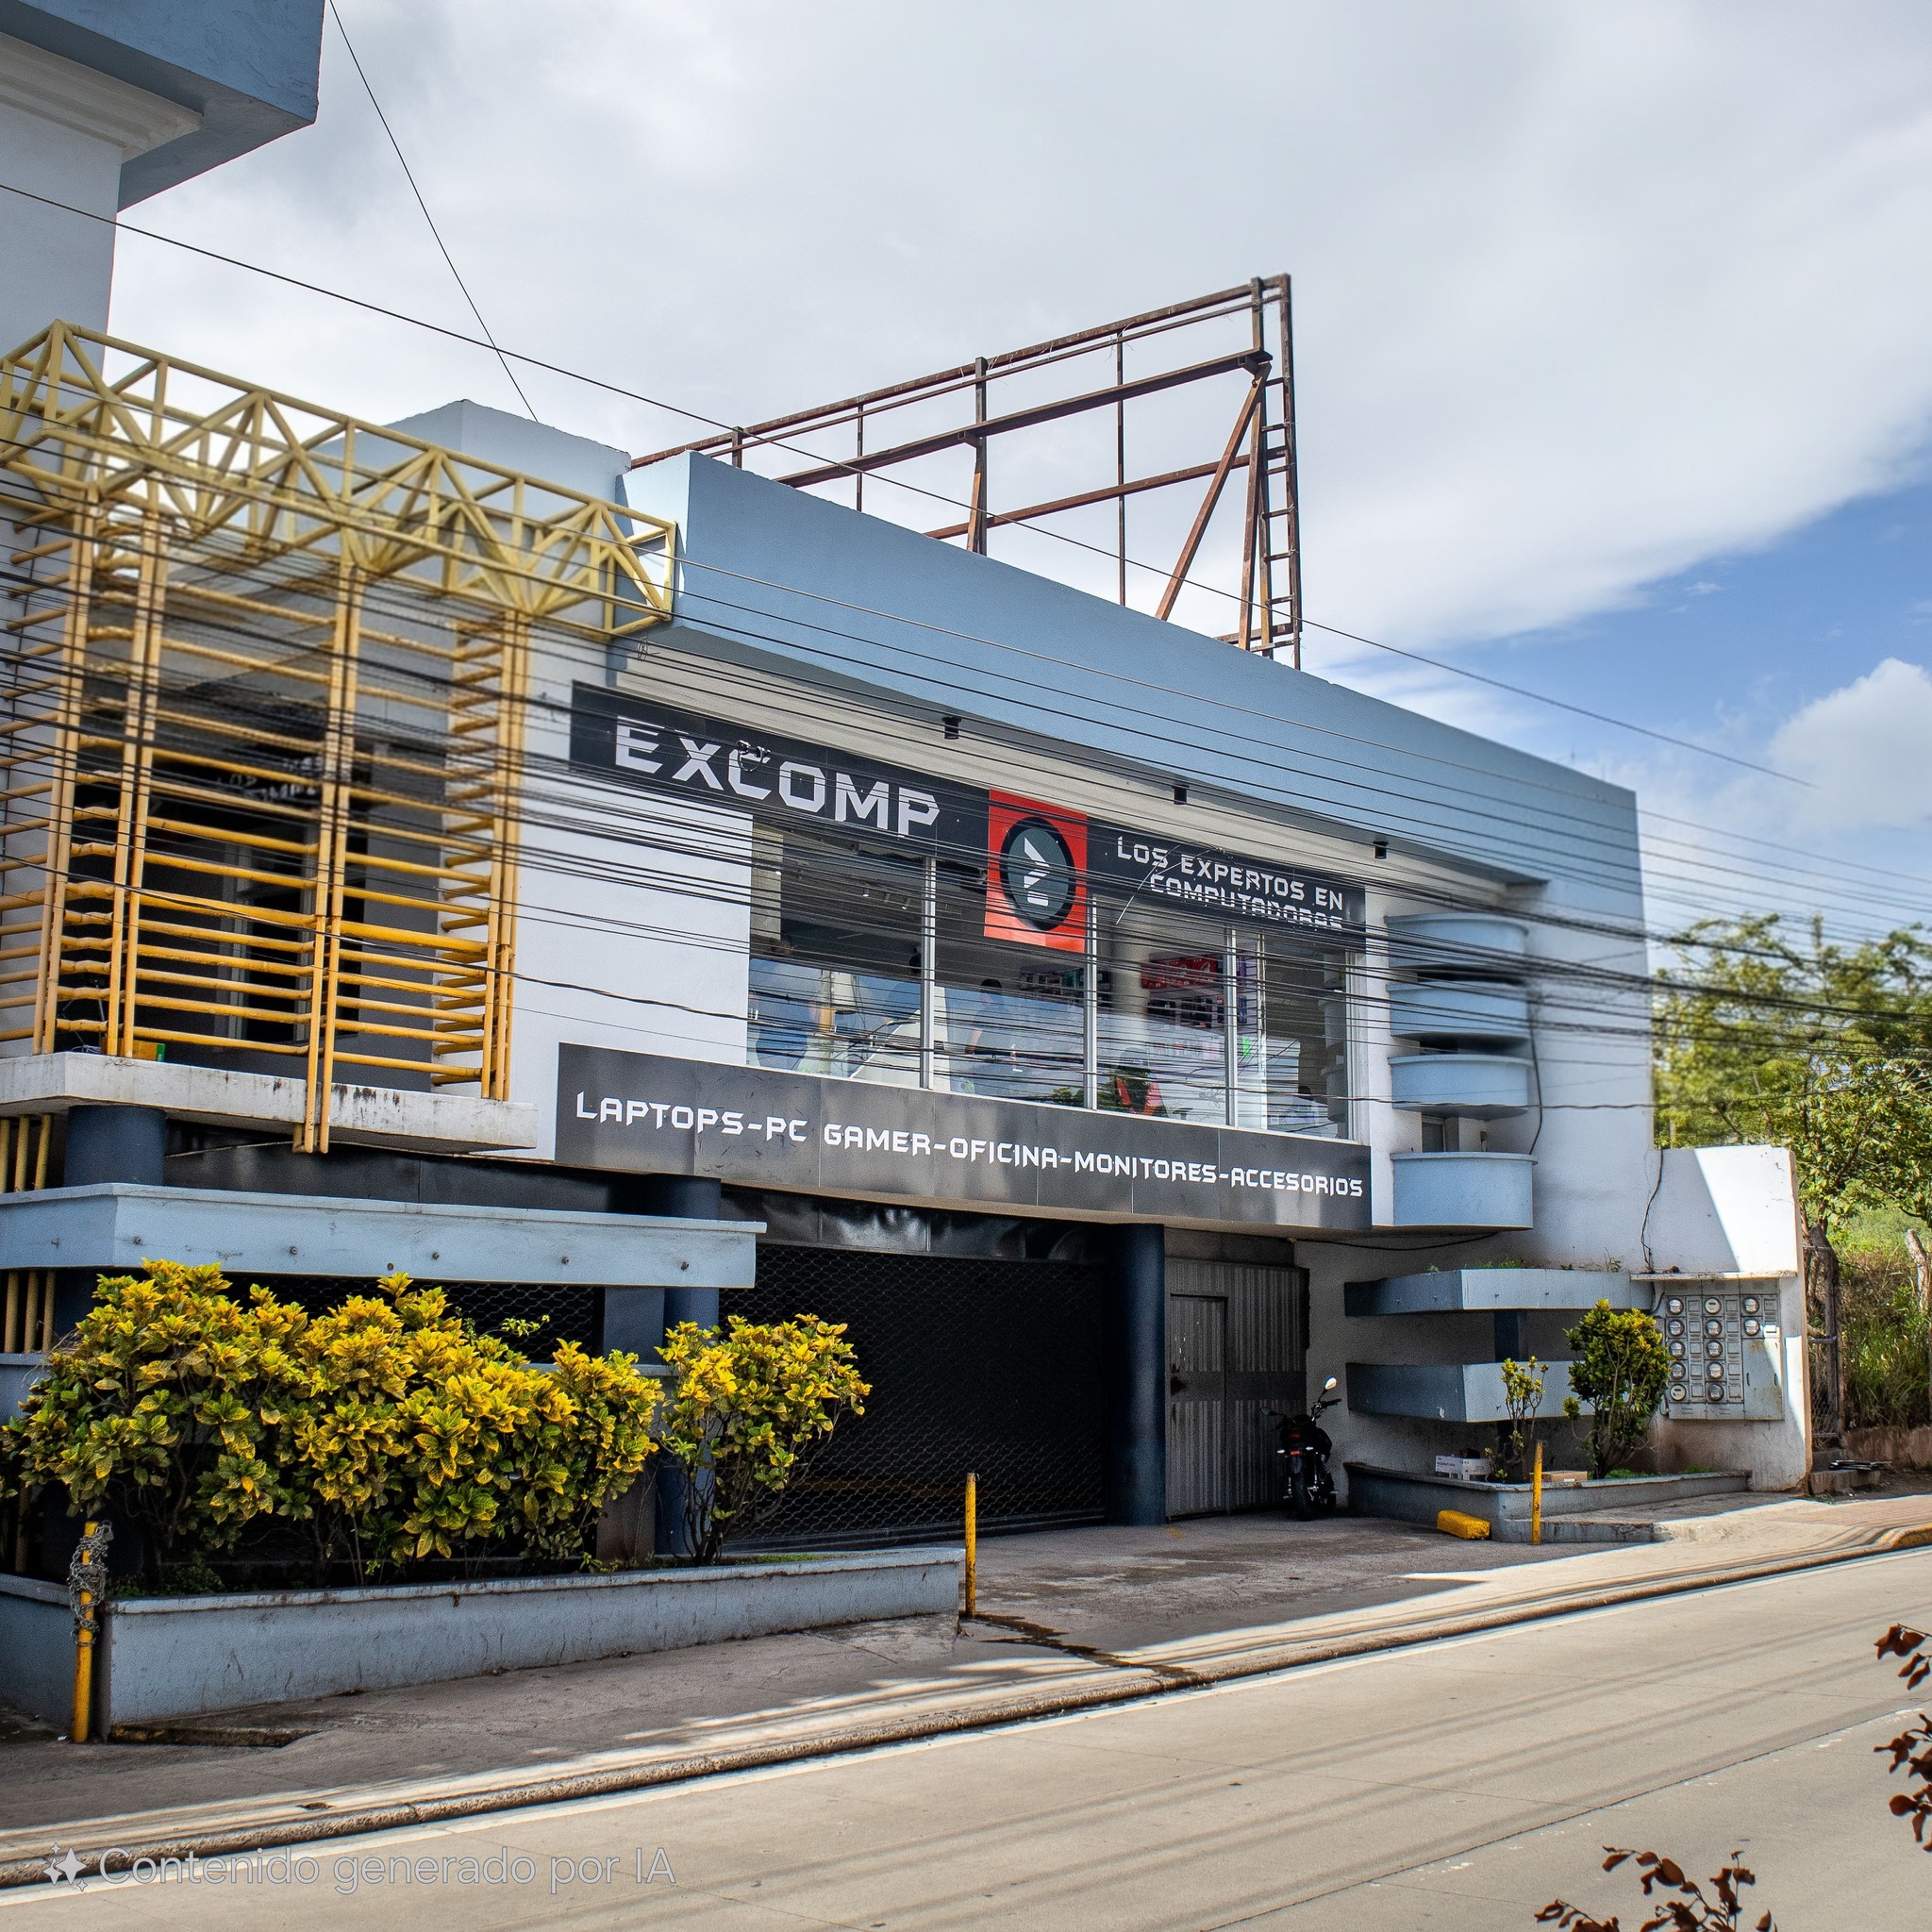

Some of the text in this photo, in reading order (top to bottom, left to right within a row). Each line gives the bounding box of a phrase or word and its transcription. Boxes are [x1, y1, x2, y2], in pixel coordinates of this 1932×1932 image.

[615, 715, 941, 838] EXCOMP
[1117, 836, 1343, 911] LOS EXPERTOS EN
